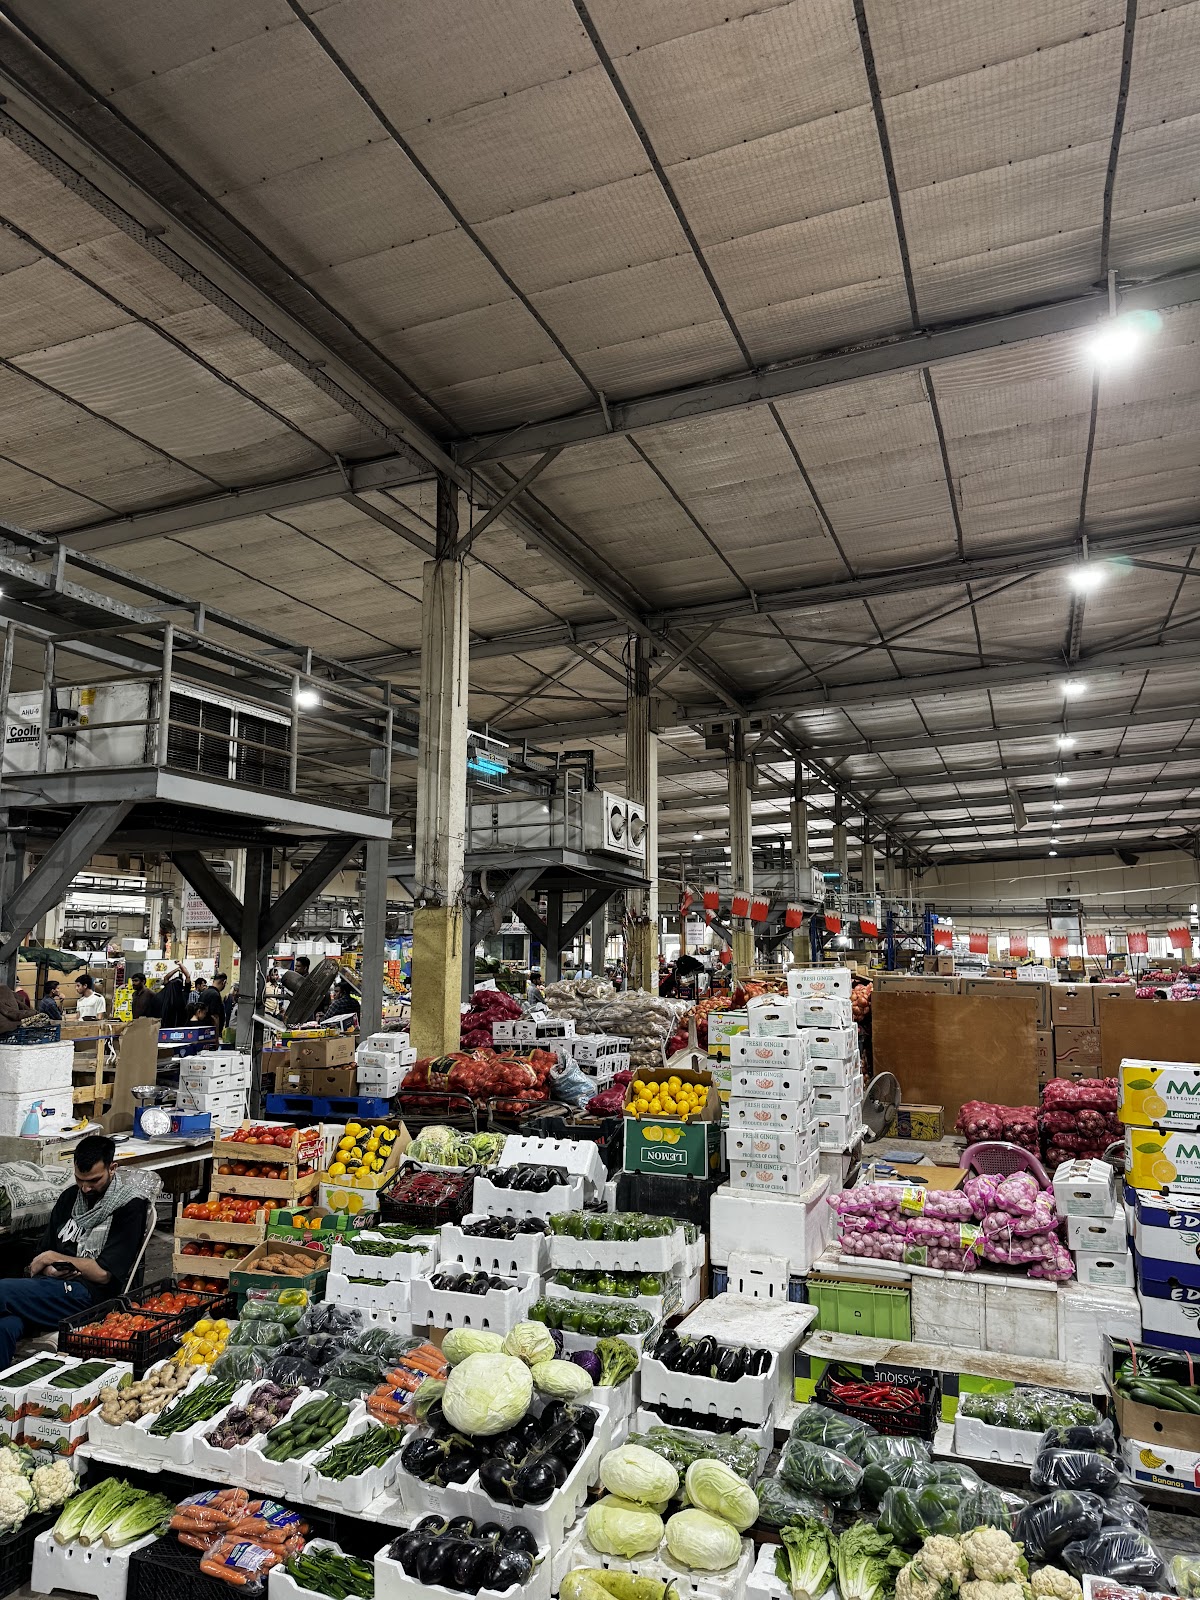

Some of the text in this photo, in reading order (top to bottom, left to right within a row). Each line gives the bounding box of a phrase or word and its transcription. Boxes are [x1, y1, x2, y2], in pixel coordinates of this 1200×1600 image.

[647, 1150, 684, 1163] LEMON
[763, 1163, 784, 1171] GINGER
[41, 1391, 64, 1404] خضروات
[38, 1425, 62, 1437] خضروات
[1152, 1475, 1185, 1489] Bananas
